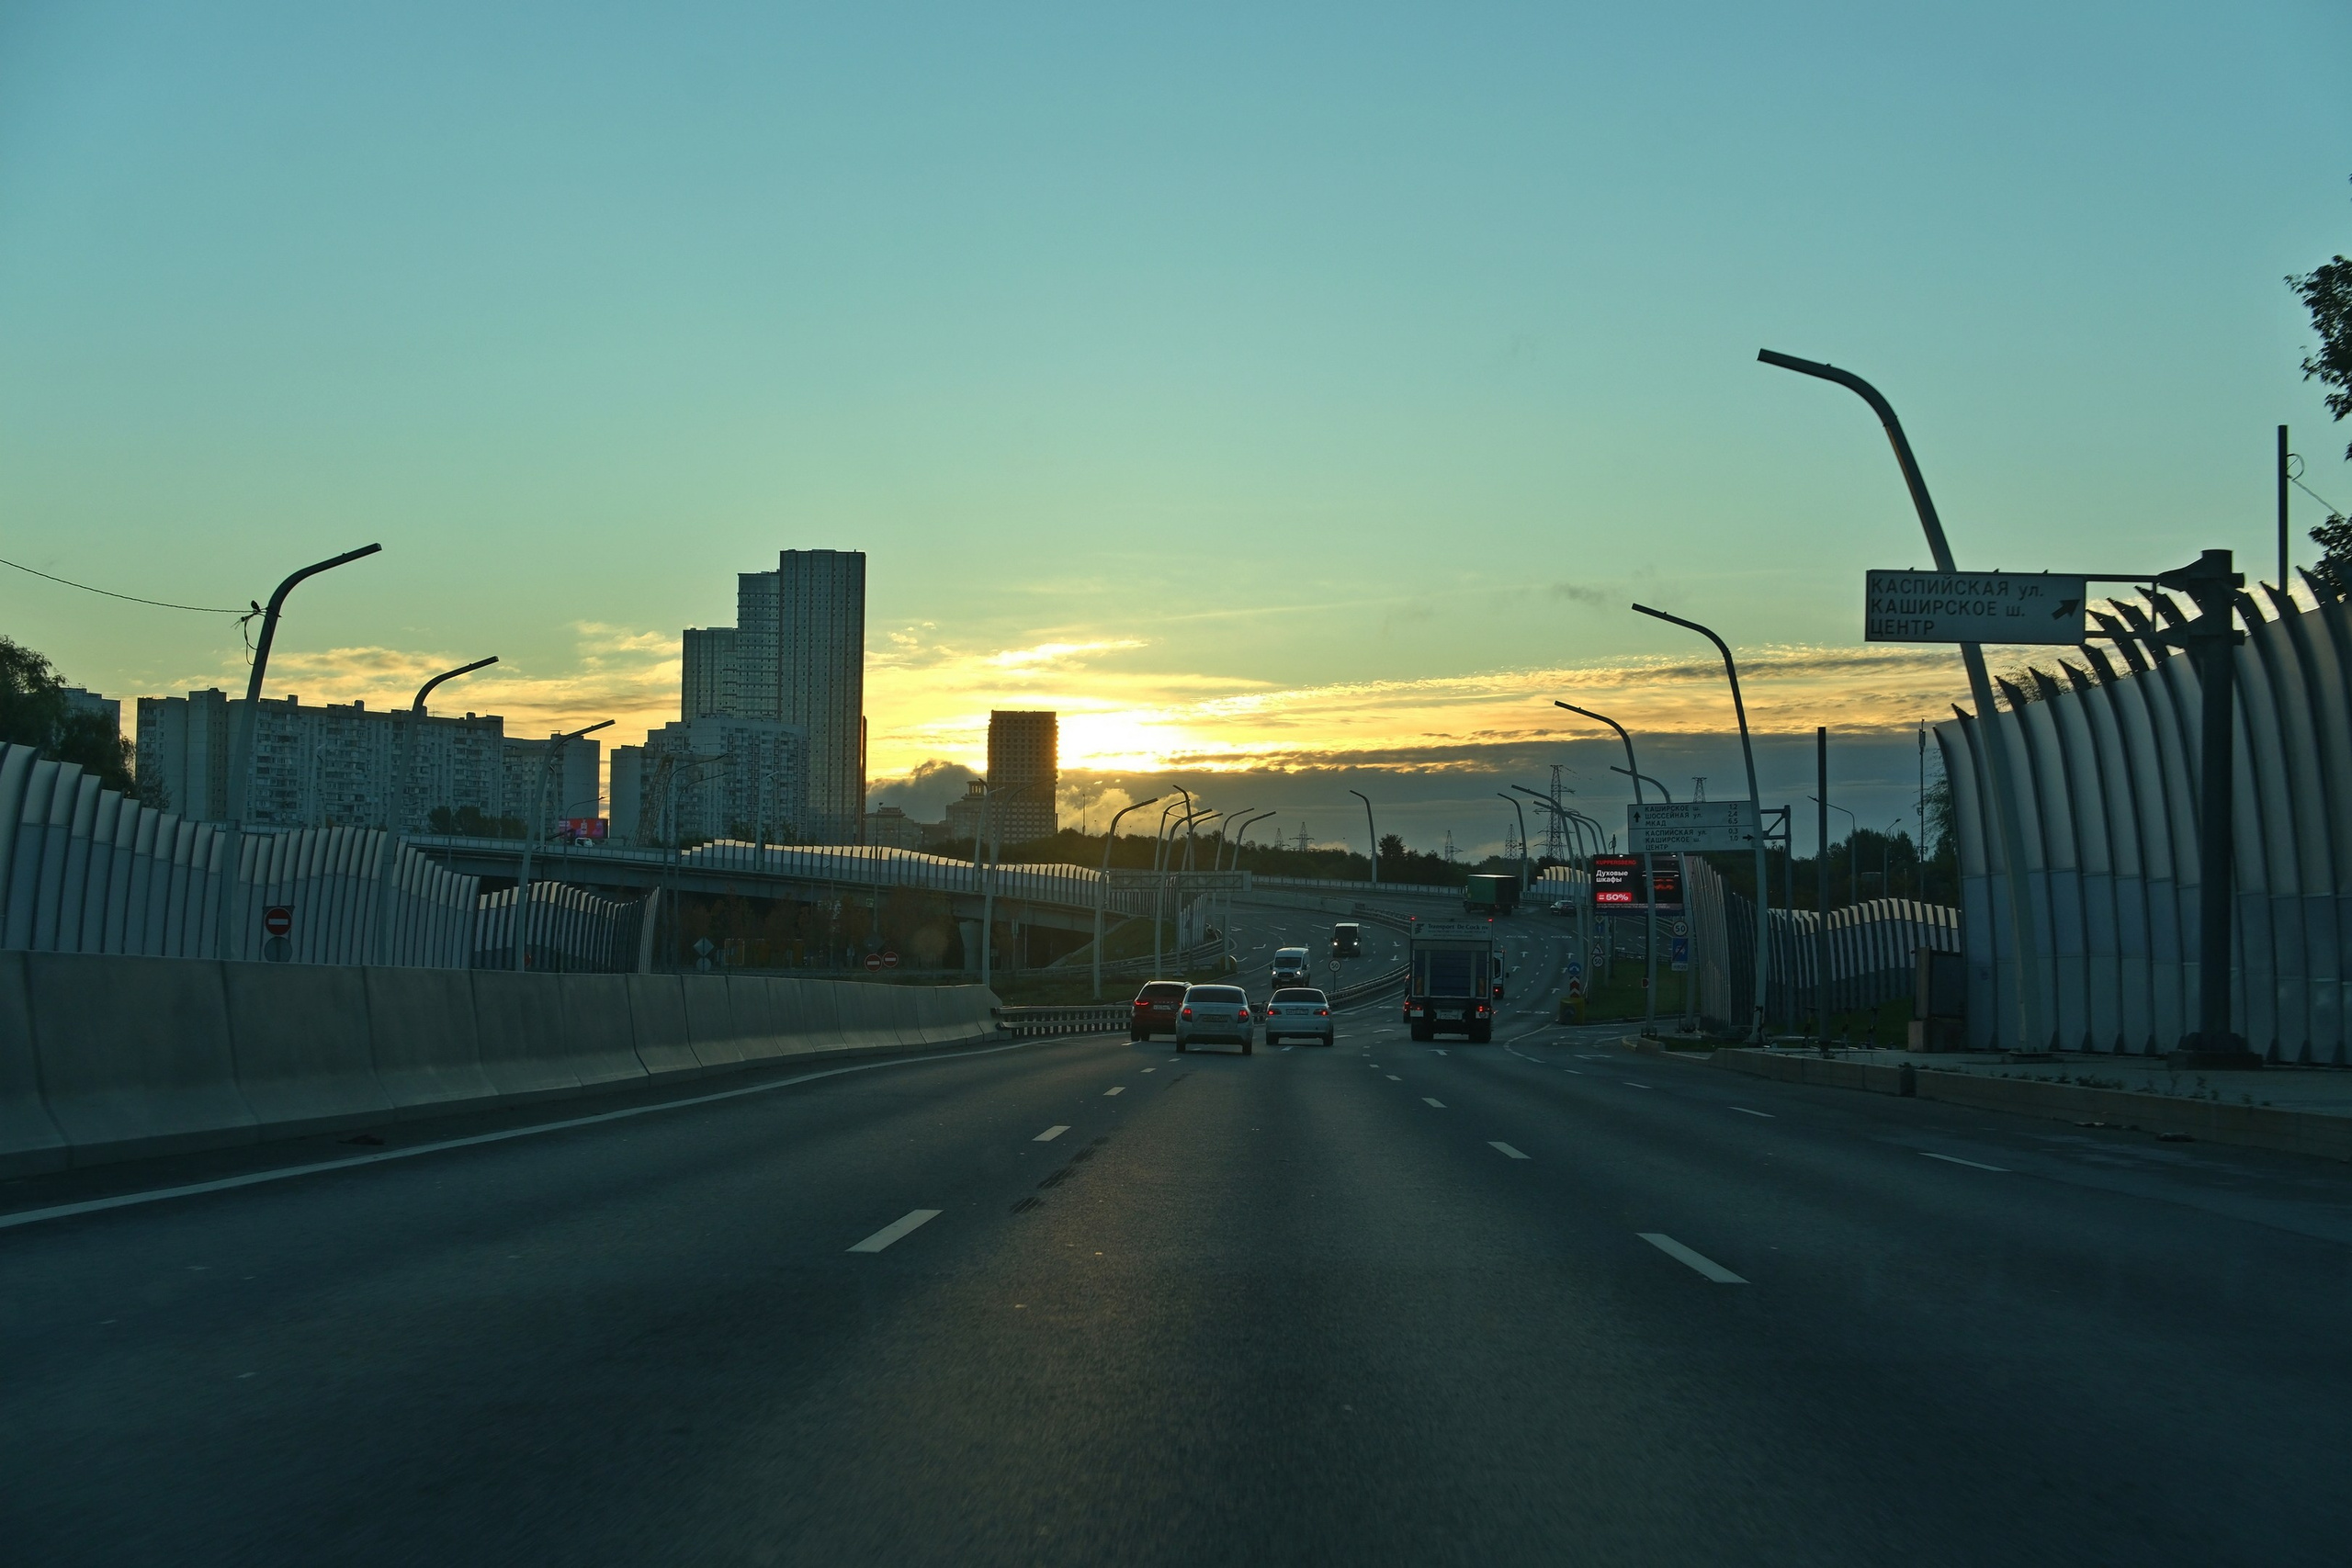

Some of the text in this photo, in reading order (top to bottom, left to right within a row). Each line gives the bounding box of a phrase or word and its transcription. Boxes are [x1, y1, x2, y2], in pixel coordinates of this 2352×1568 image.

[1871, 576, 2043, 600] КАСПИЙСКАЯ ул.
[1871, 599, 2025, 617] КАШИРСКОЕ ш.
[1871, 619, 1935, 637] ЦЕНТР
